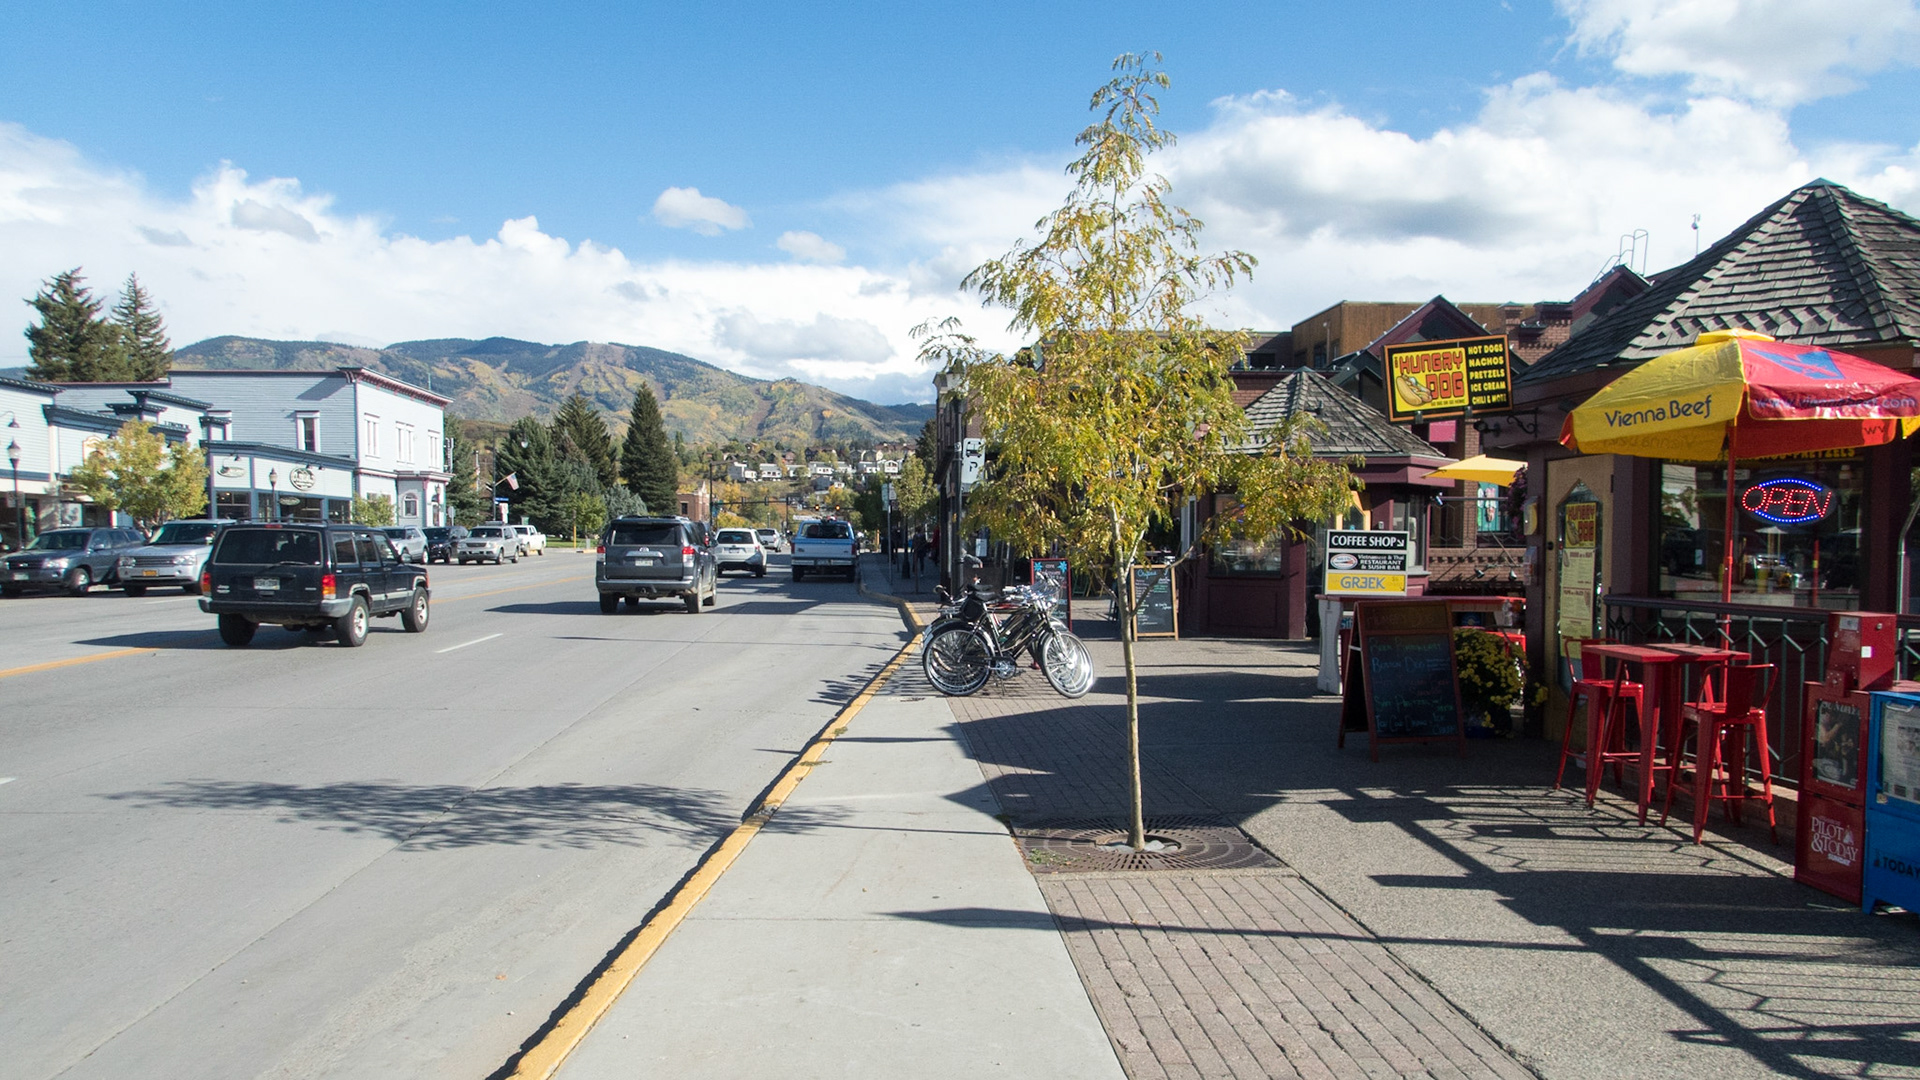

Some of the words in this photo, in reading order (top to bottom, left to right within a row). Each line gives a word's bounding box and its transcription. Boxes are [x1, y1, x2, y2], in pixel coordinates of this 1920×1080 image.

[1468, 346, 1482, 355] HOT
[1484, 344, 1503, 353] DOGS
[1400, 351, 1463, 375] HUNGRY
[1469, 356, 1504, 367] NACHOS
[1469, 368, 1505, 379] PRETZELS
[1426, 371, 1464, 400] DOG
[1470, 382, 1482, 392] ICE
[1482, 381, 1506, 391] CREAM
[1605, 407, 1666, 427] Vienna
[1668, 395, 1712, 419] Beef
[1742, 485, 1832, 518] OPEN
[1331, 535, 1367, 546] COFFEE
[1369, 536, 1396, 547] SHOP
[1340, 576, 1386, 589] GREEK
[1811, 816, 1845, 841] PILOT
[1883, 856, 1920, 880] TODAY
